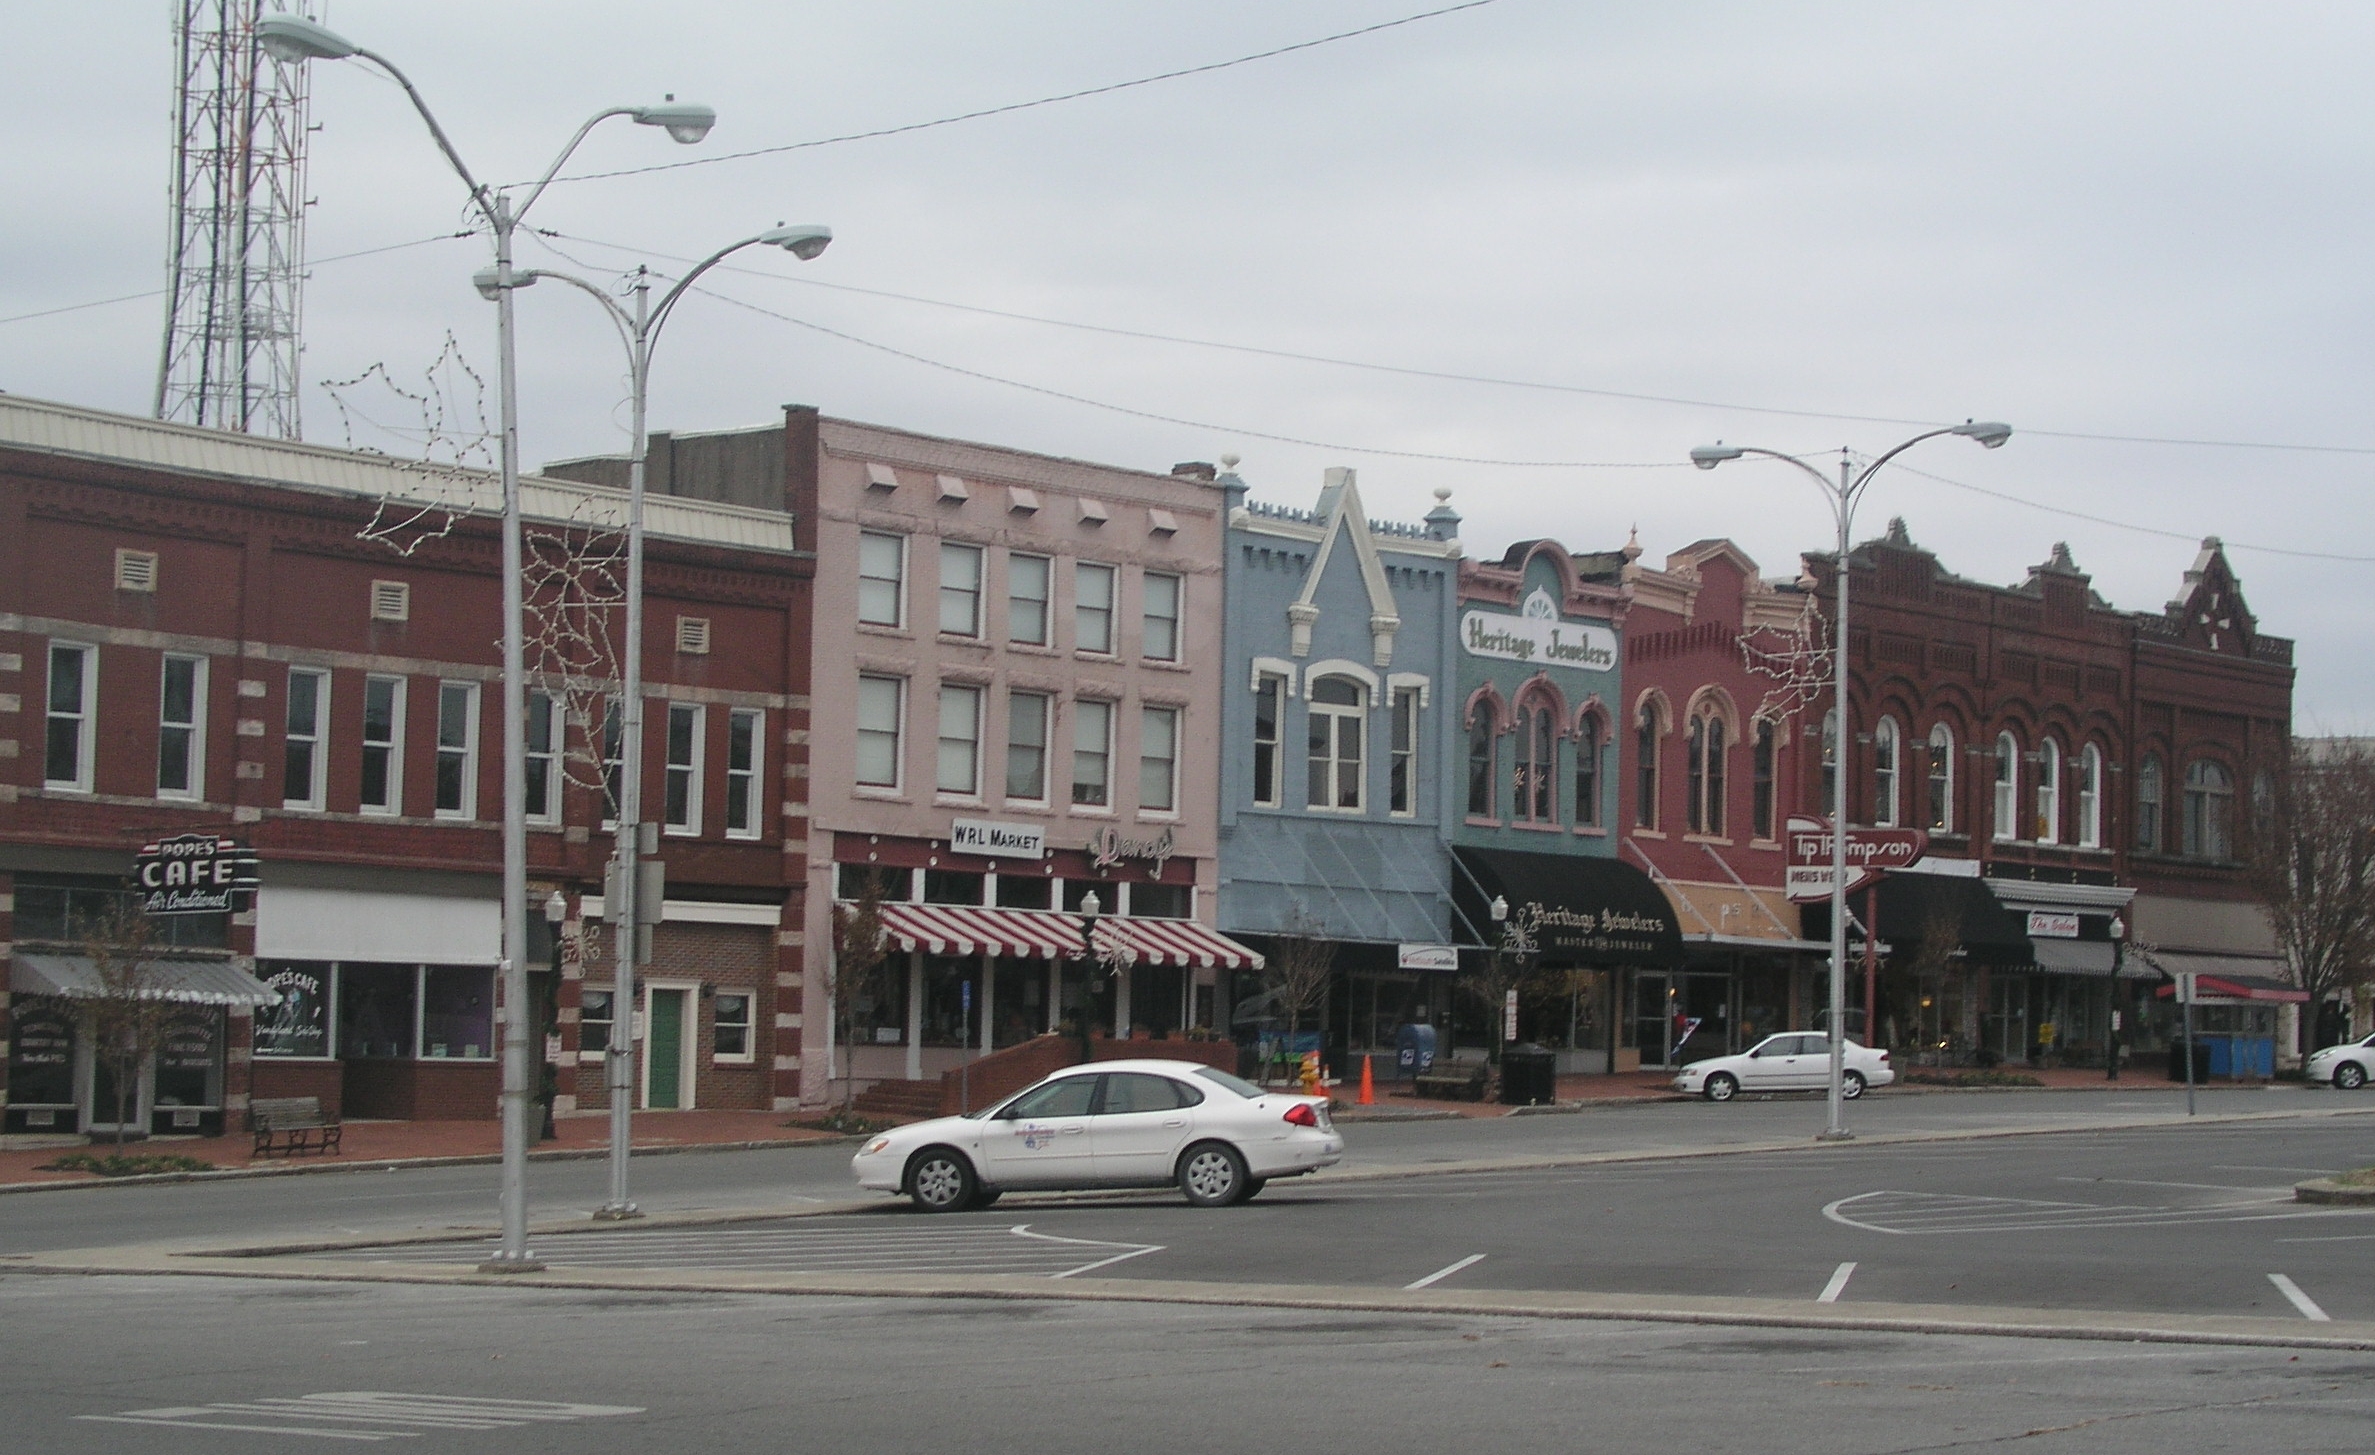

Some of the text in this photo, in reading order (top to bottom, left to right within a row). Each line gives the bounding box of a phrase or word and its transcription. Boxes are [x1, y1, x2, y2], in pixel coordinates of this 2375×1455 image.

[1469, 617, 1612, 664] Heritage Jewelers
[955, 826, 985, 845] WRL
[1820, 834, 1912, 865] Thmpson
[142, 859, 234, 887] CAFE
[146, 889, 229, 910] Air Conditioned
[1527, 901, 1664, 934] Heritage Jewelers
[268, 967, 320, 995] OPE'S CAFE
